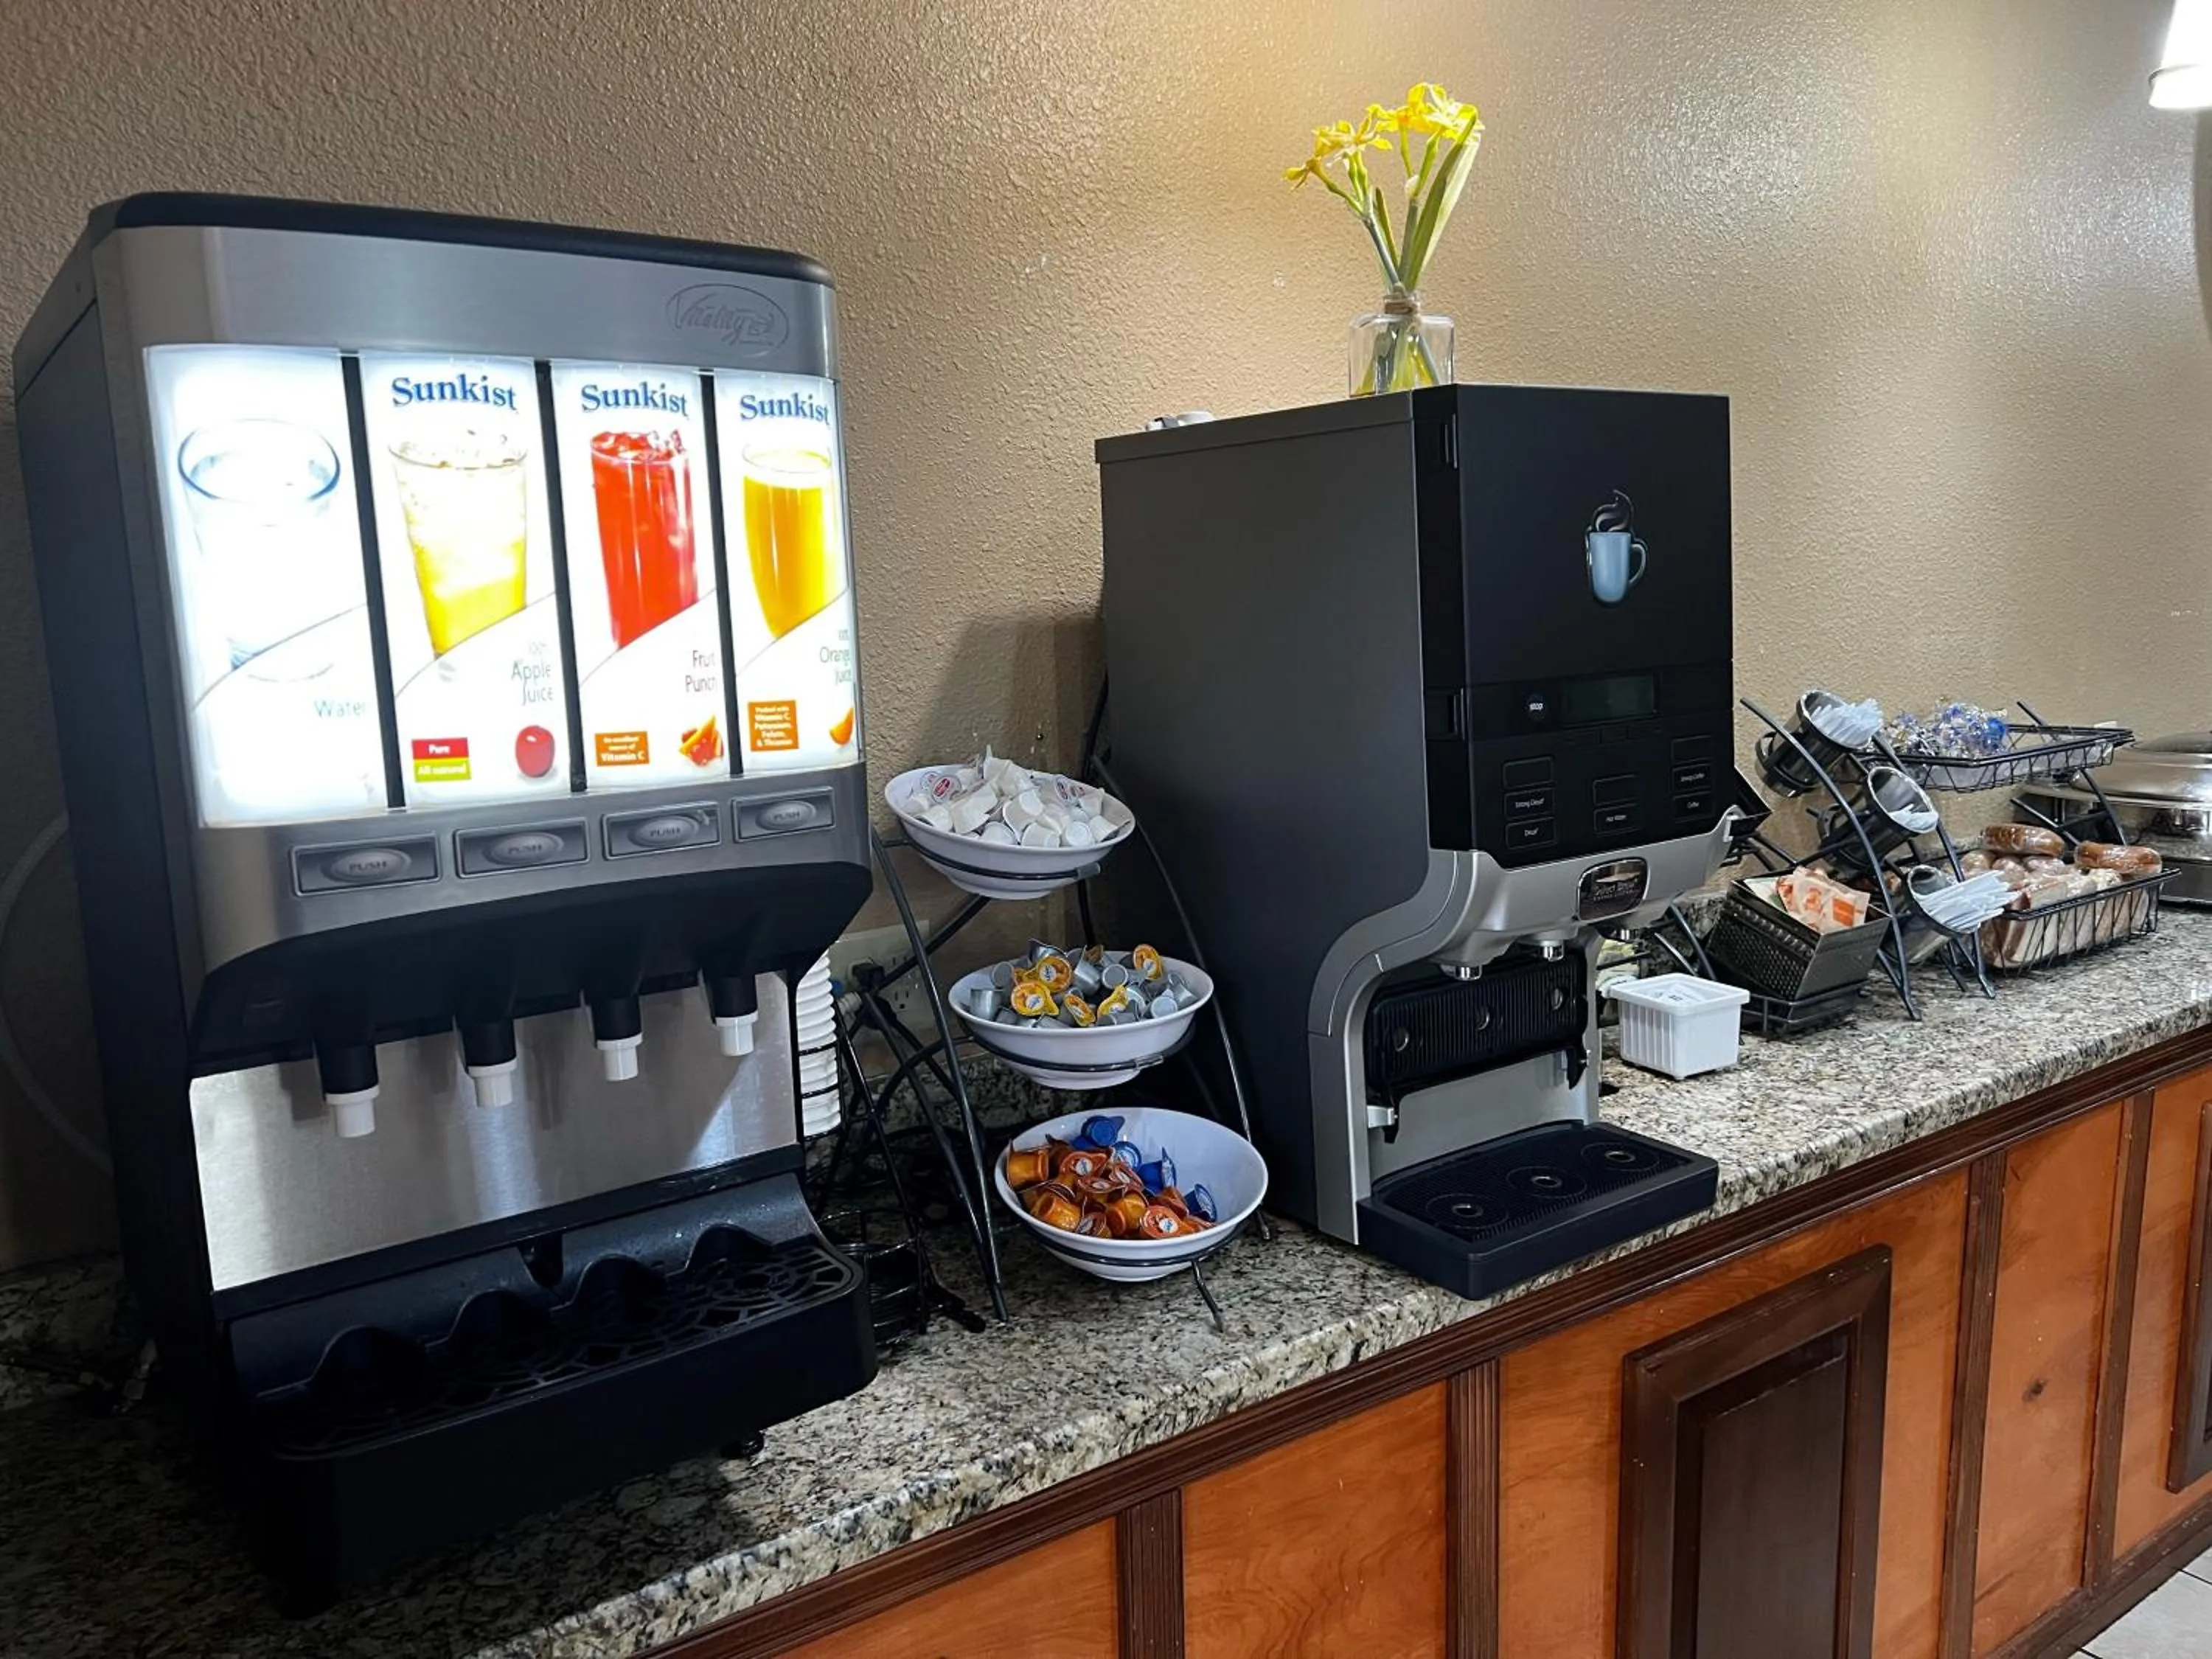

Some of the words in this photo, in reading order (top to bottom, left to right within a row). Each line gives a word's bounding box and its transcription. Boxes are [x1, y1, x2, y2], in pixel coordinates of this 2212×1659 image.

[391, 372, 517, 411] Sunkist
[580, 380, 689, 417] Sunkist
[740, 392, 831, 425] Sunkist
[510, 658, 552, 686] Apple
[521, 686, 554, 706] Juice
[601, 751, 637, 762] Vitamin
[638, 750, 647, 760] C
[773, 810, 801, 821] PUSH
[649, 827, 681, 838] PUSH
[507, 843, 543, 856] PUSH
[349, 860, 387, 873] PUSH
